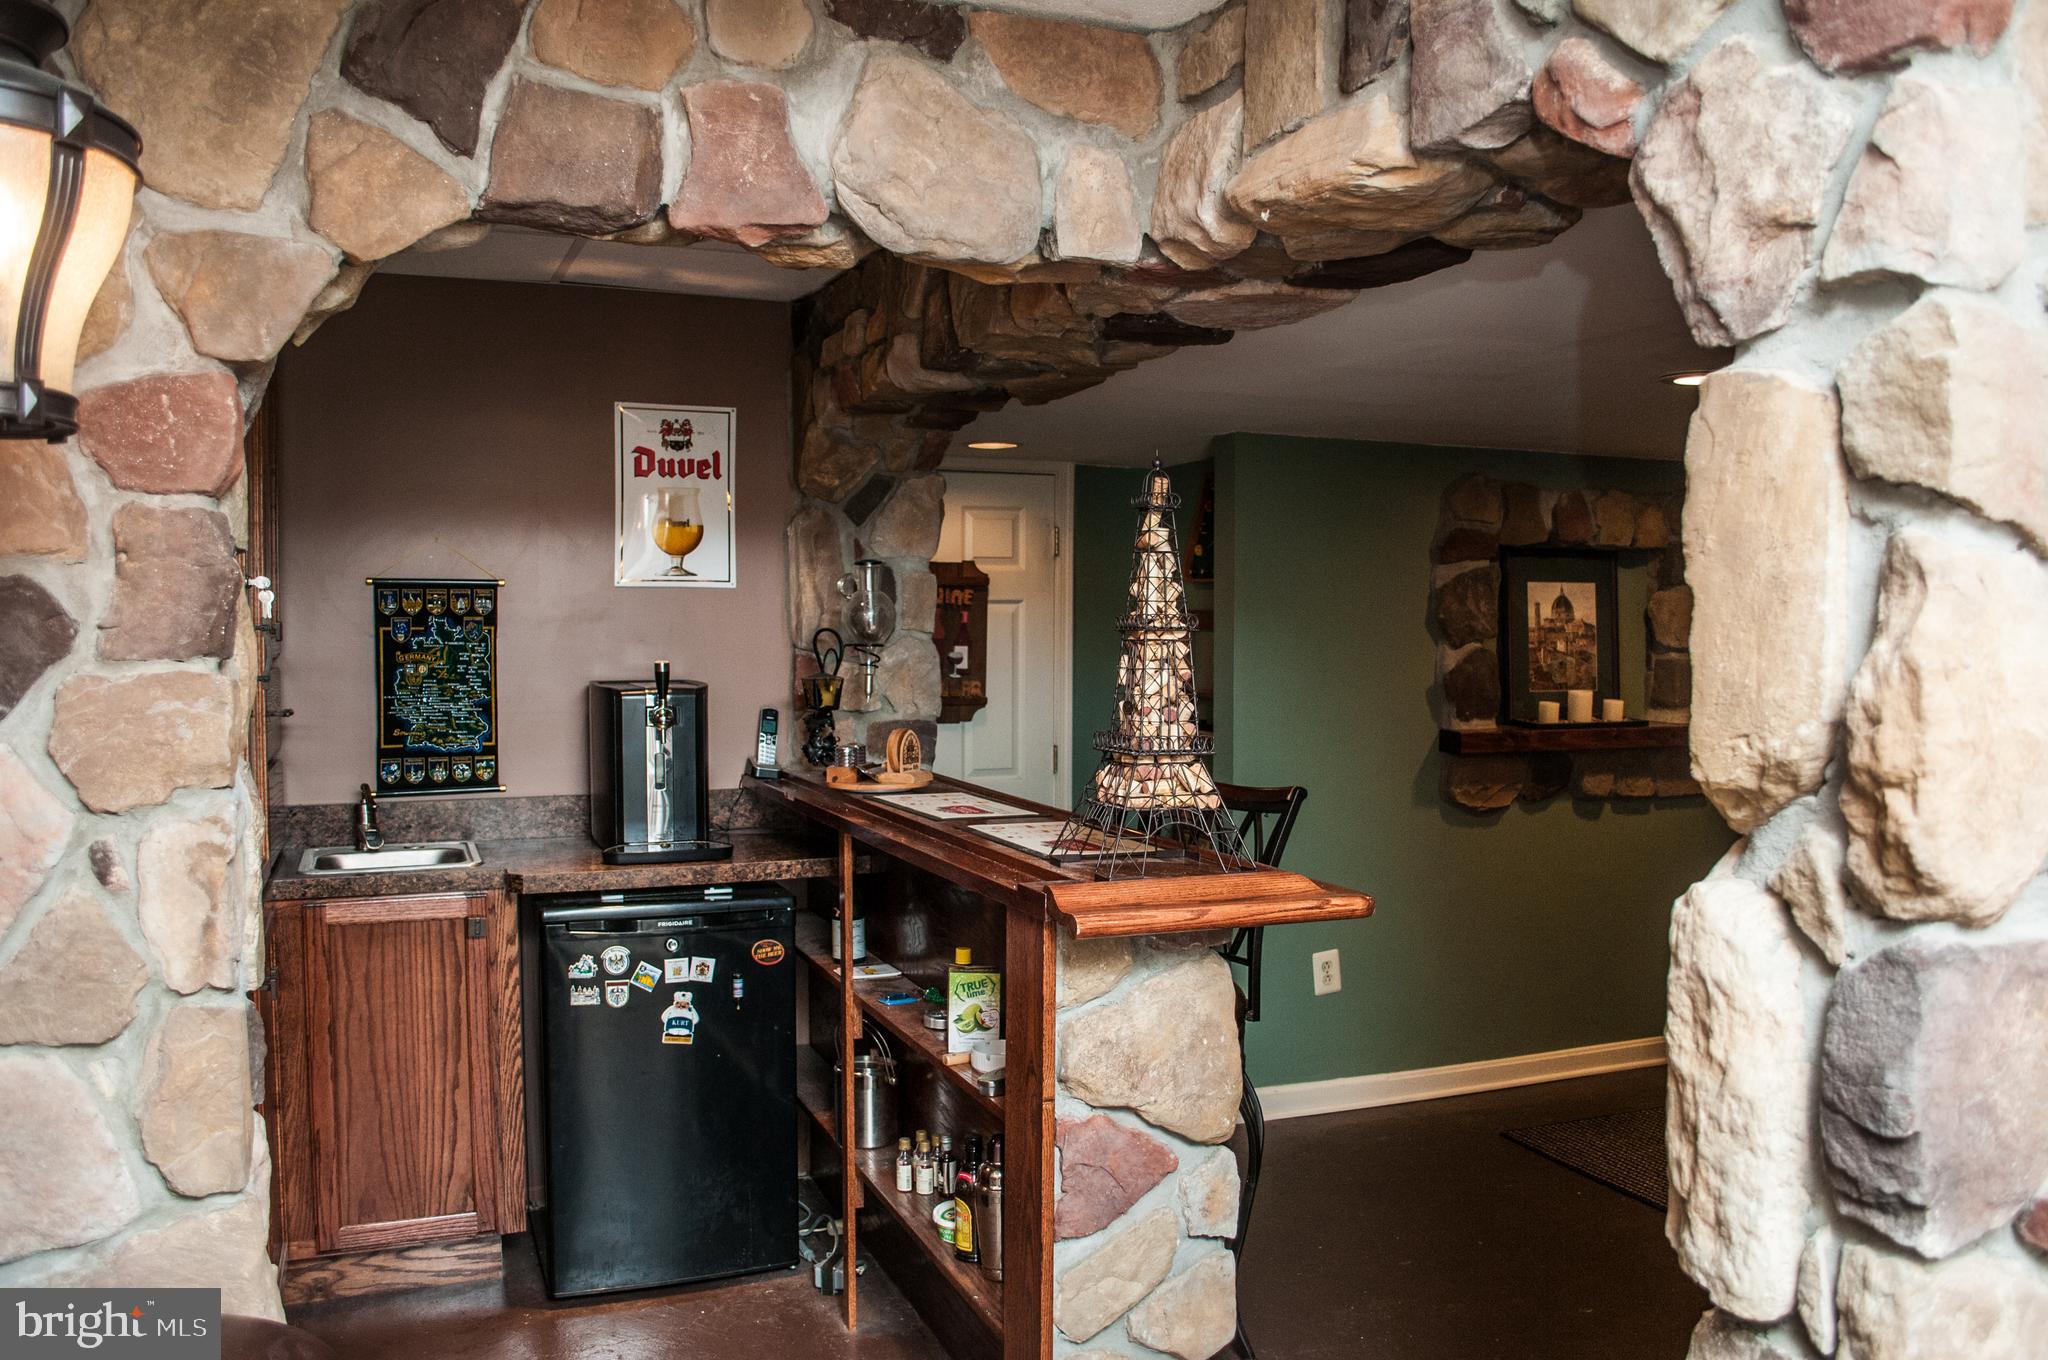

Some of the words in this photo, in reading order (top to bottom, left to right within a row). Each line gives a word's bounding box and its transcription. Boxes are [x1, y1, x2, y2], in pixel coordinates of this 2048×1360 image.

[631, 445, 722, 480] Duvel
[399, 653, 436, 663] GERMANY
[657, 919, 693, 928] FRIGIDAIRE
[960, 979, 988, 992] TRUE
[967, 990, 986, 998] lime
